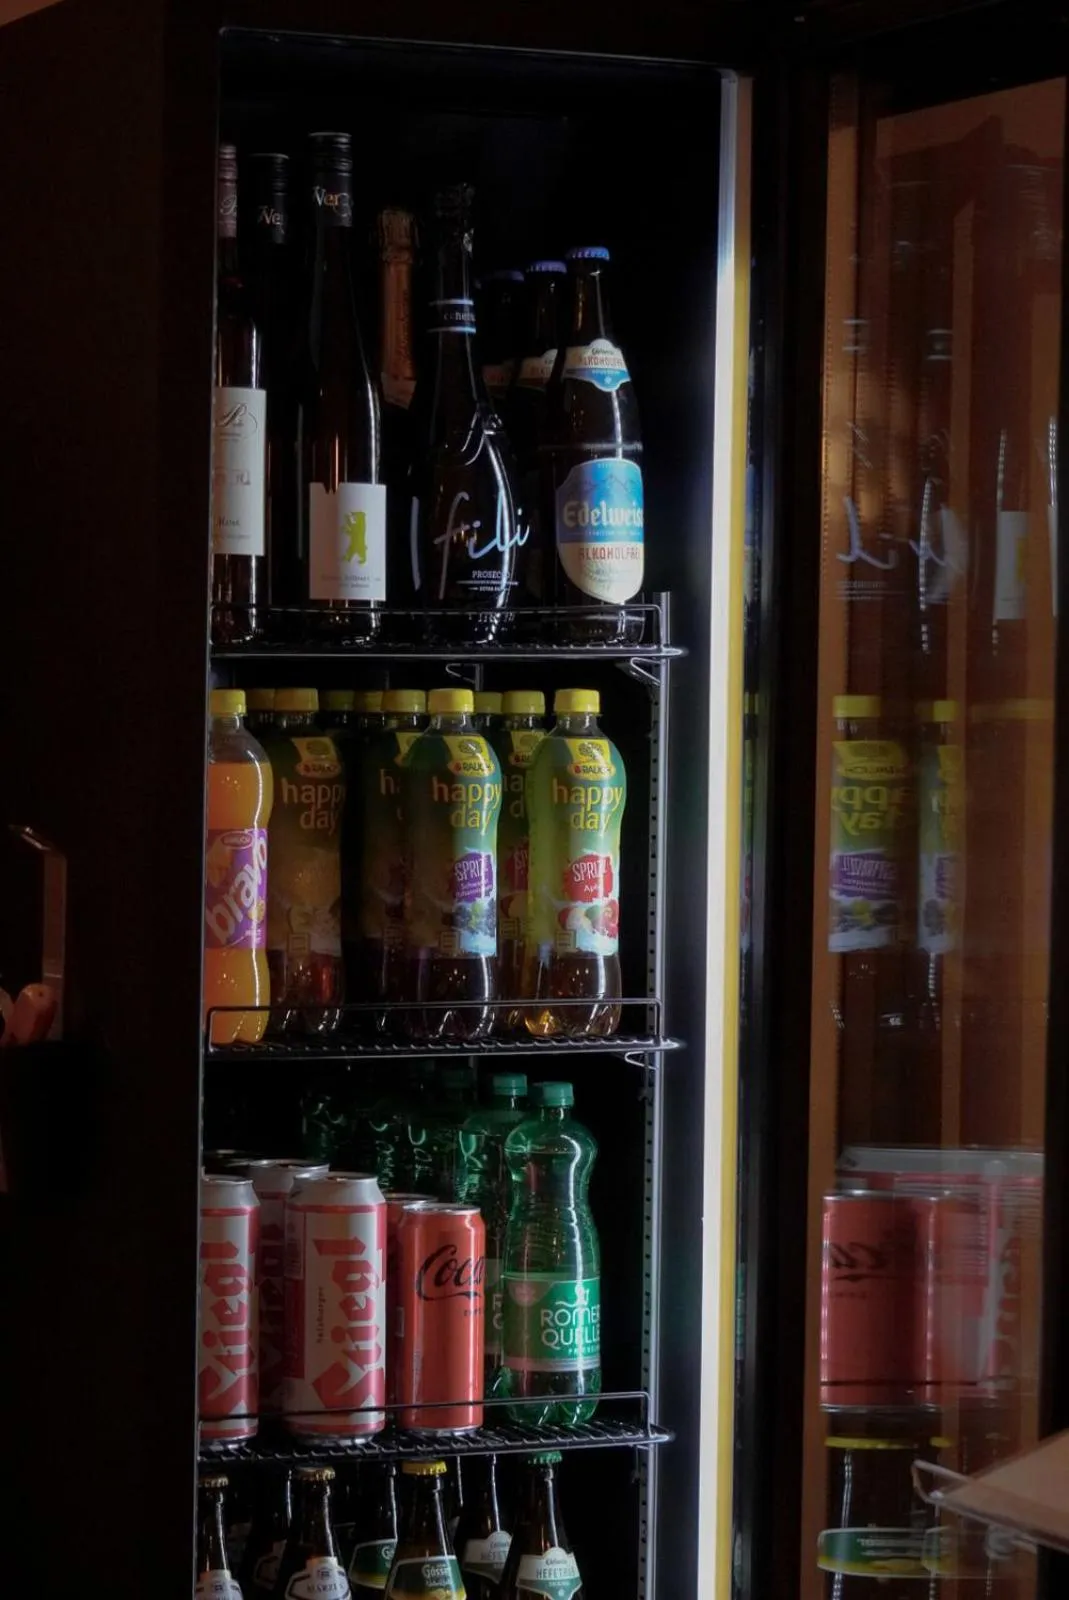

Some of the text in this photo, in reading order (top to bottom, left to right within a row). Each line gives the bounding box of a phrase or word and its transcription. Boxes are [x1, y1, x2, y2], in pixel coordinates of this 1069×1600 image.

[472, 570, 510, 579] PROSECO
[432, 776, 501, 810] happy
[552, 778, 624, 811] happy
[299, 804, 339, 836] day
[450, 808, 492, 836] day
[569, 808, 610, 835] day
[454, 857, 489, 881] SPRIT
[572, 858, 607, 883] SPRIT
[312, 1236, 386, 1410] Stiegl
[541, 1325, 600, 1350] QUELL
